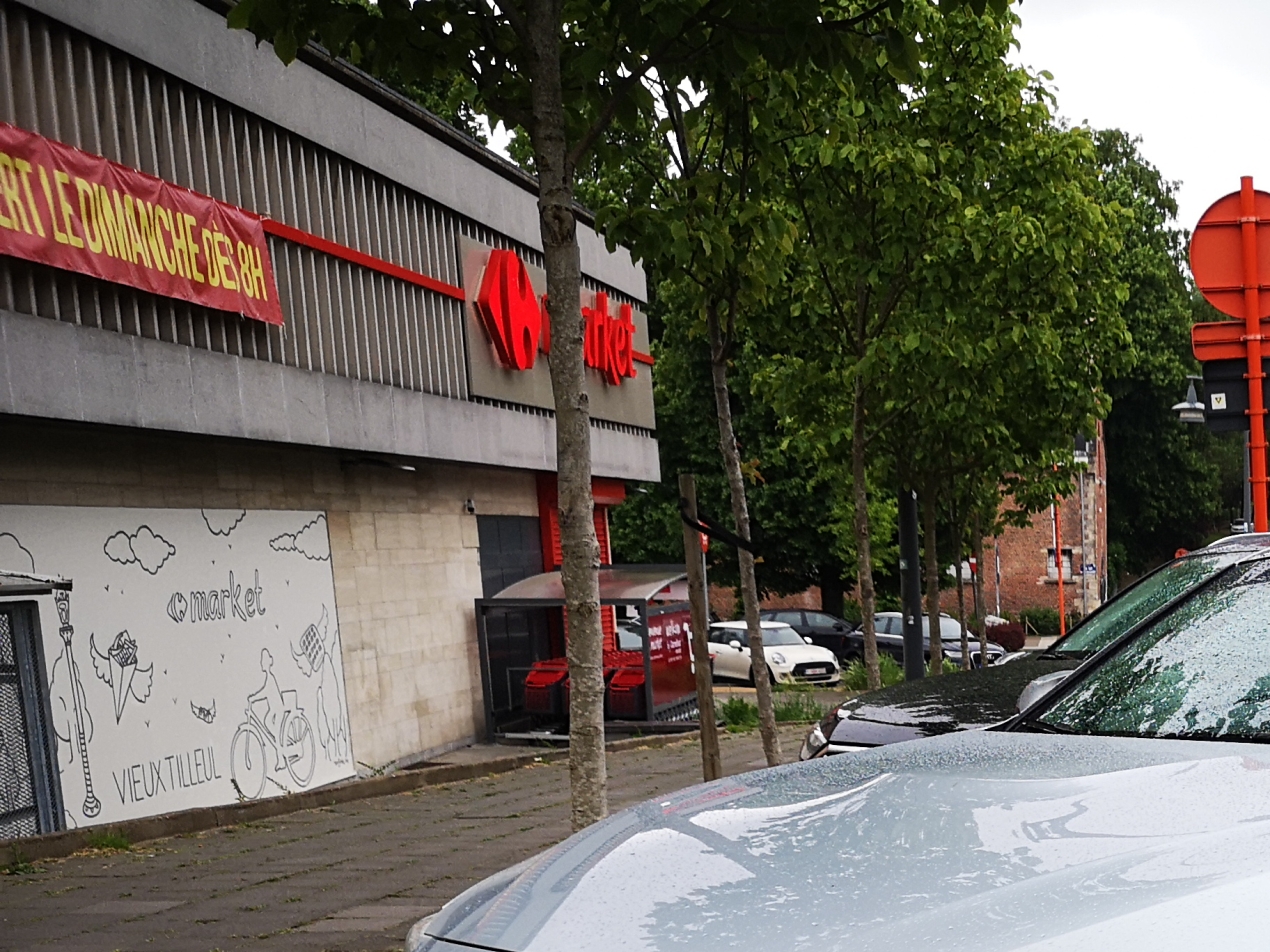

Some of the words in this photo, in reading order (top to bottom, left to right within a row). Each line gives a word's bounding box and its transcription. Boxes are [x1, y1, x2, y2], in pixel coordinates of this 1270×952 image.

[38, 164, 84, 249] LE
[74, 177, 205, 284] DIMANCHE
[237, 240, 268, 302] 8H
[541, 291, 638, 386] arket
[190, 569, 267, 623] market
[112, 759, 167, 806] VIEUX
[164, 746, 222, 791] TILLEUL
